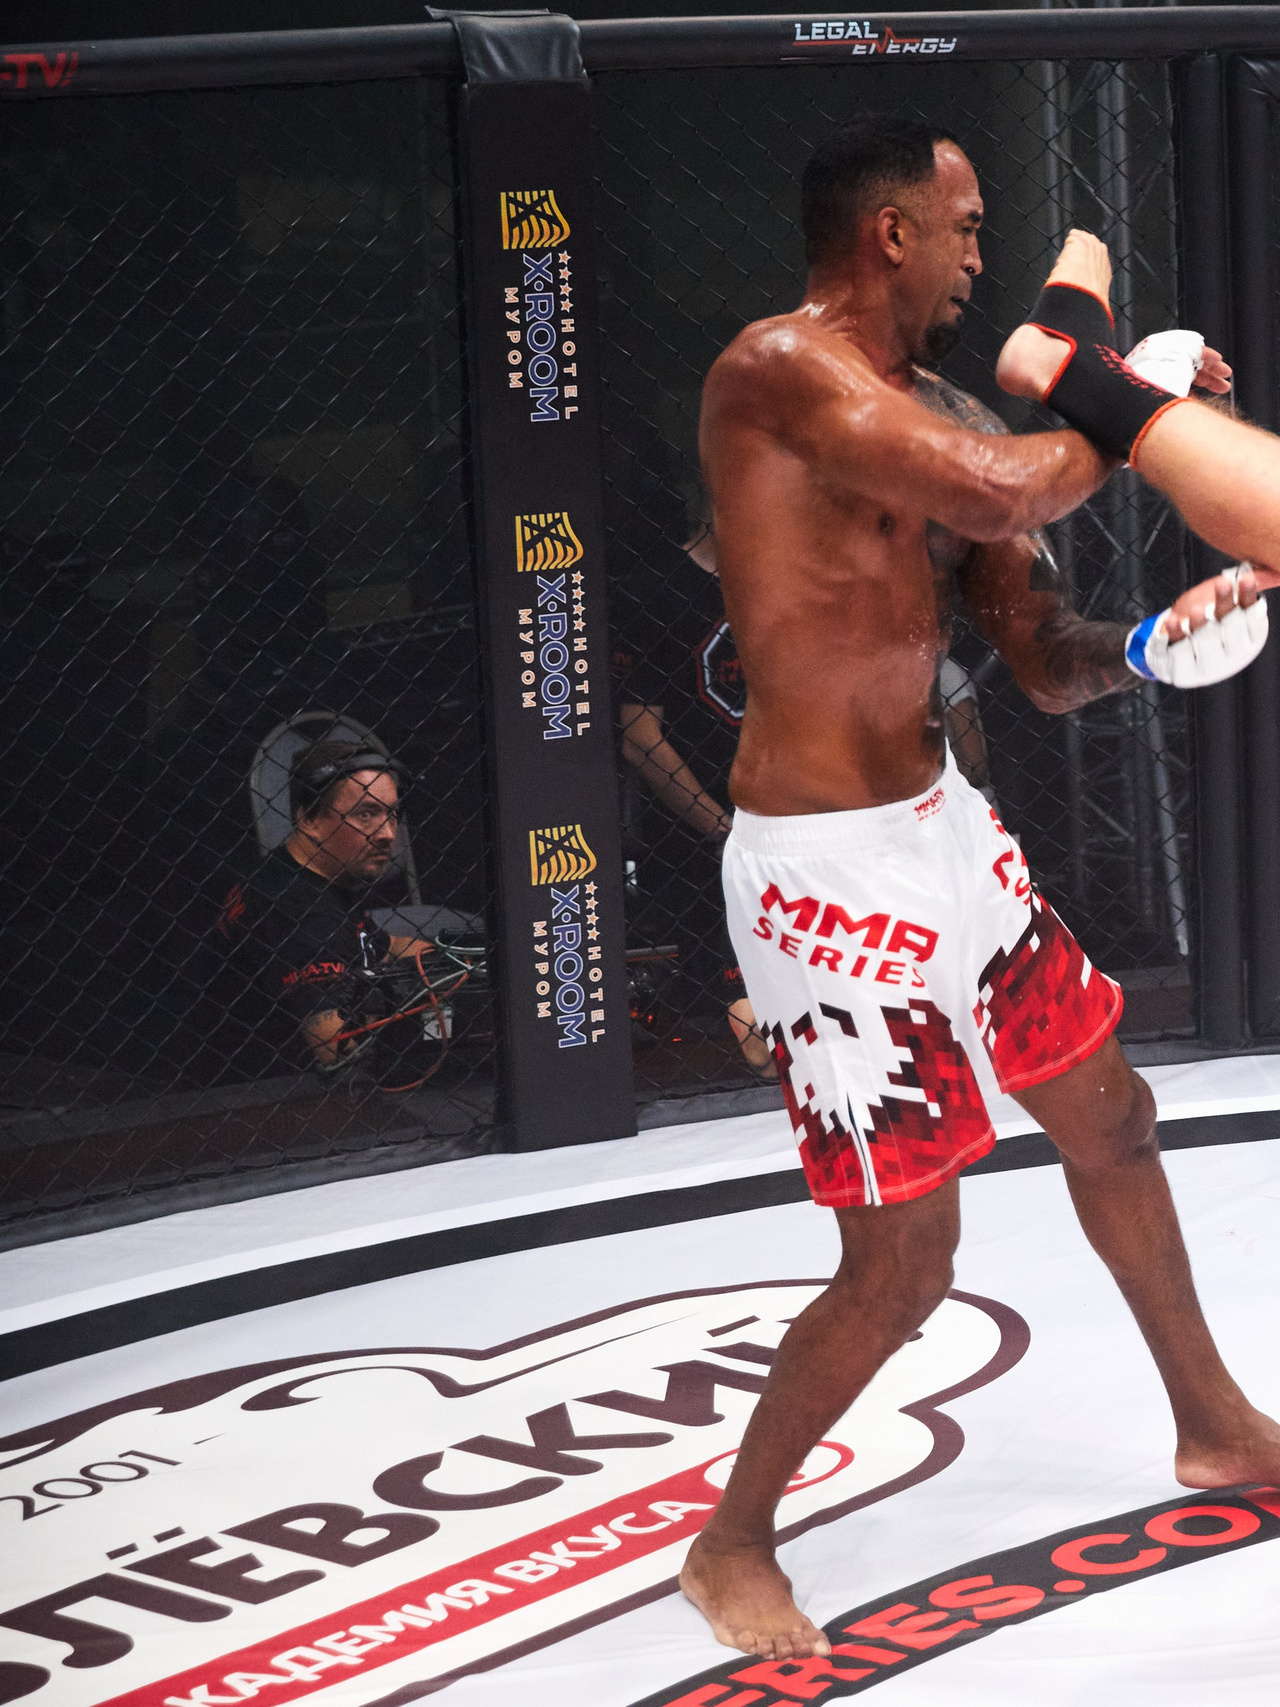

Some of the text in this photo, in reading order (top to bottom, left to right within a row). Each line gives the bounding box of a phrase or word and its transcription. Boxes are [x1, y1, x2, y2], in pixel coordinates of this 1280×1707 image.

[795, 21, 879, 40] LEGAL
[852, 38, 957, 55] ENERGY
[561, 318, 579, 420] HOTEL
[573, 637, 591, 736] HOTEL
[753, 915, 926, 988] SERIES
[760, 881, 940, 964] MMA
[587, 946, 605, 1042] HOTEL
[0, 1450, 182, 1521] 2001
[493, 1500, 715, 1584] ВКУСА
